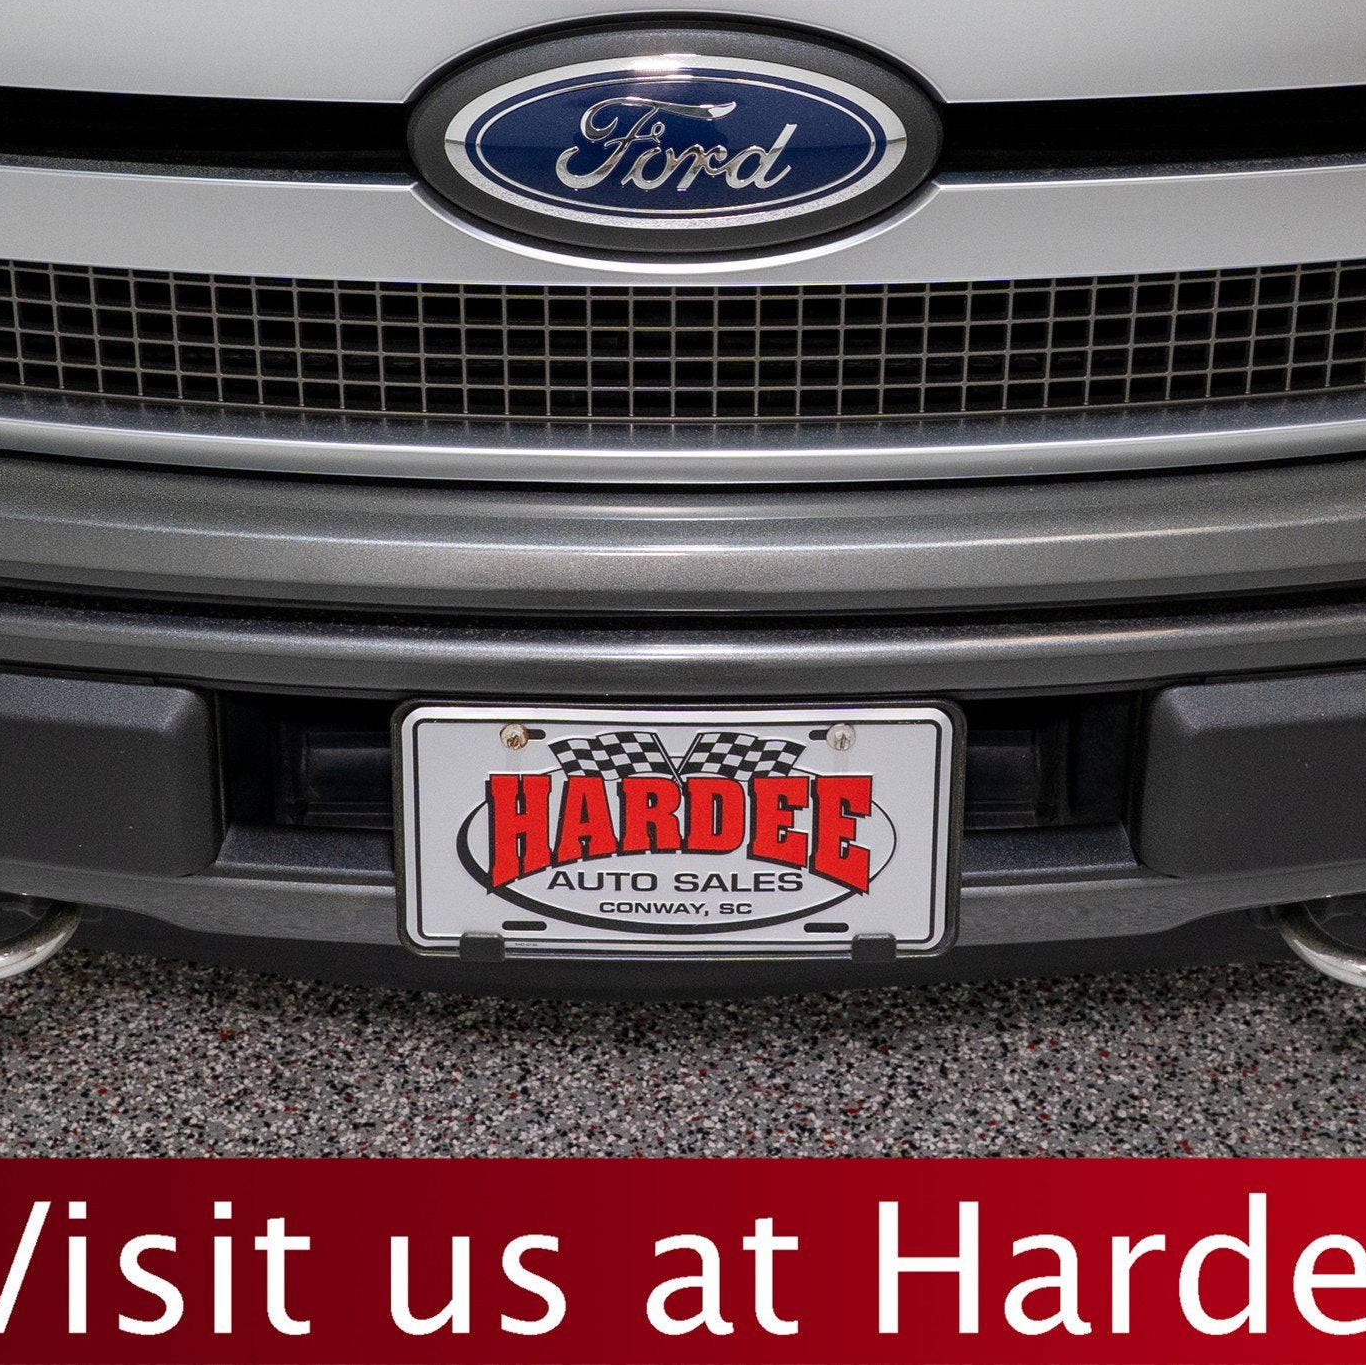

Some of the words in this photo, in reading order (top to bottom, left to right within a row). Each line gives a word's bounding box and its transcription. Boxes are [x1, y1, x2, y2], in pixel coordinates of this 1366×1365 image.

[555, 96, 798, 192] Ford
[485, 774, 873, 895] HARDEE
[547, 871, 658, 892] AUTO
[673, 872, 804, 893] SALES
[599, 901, 710, 917] CONWAY,
[719, 902, 753, 915] SC
